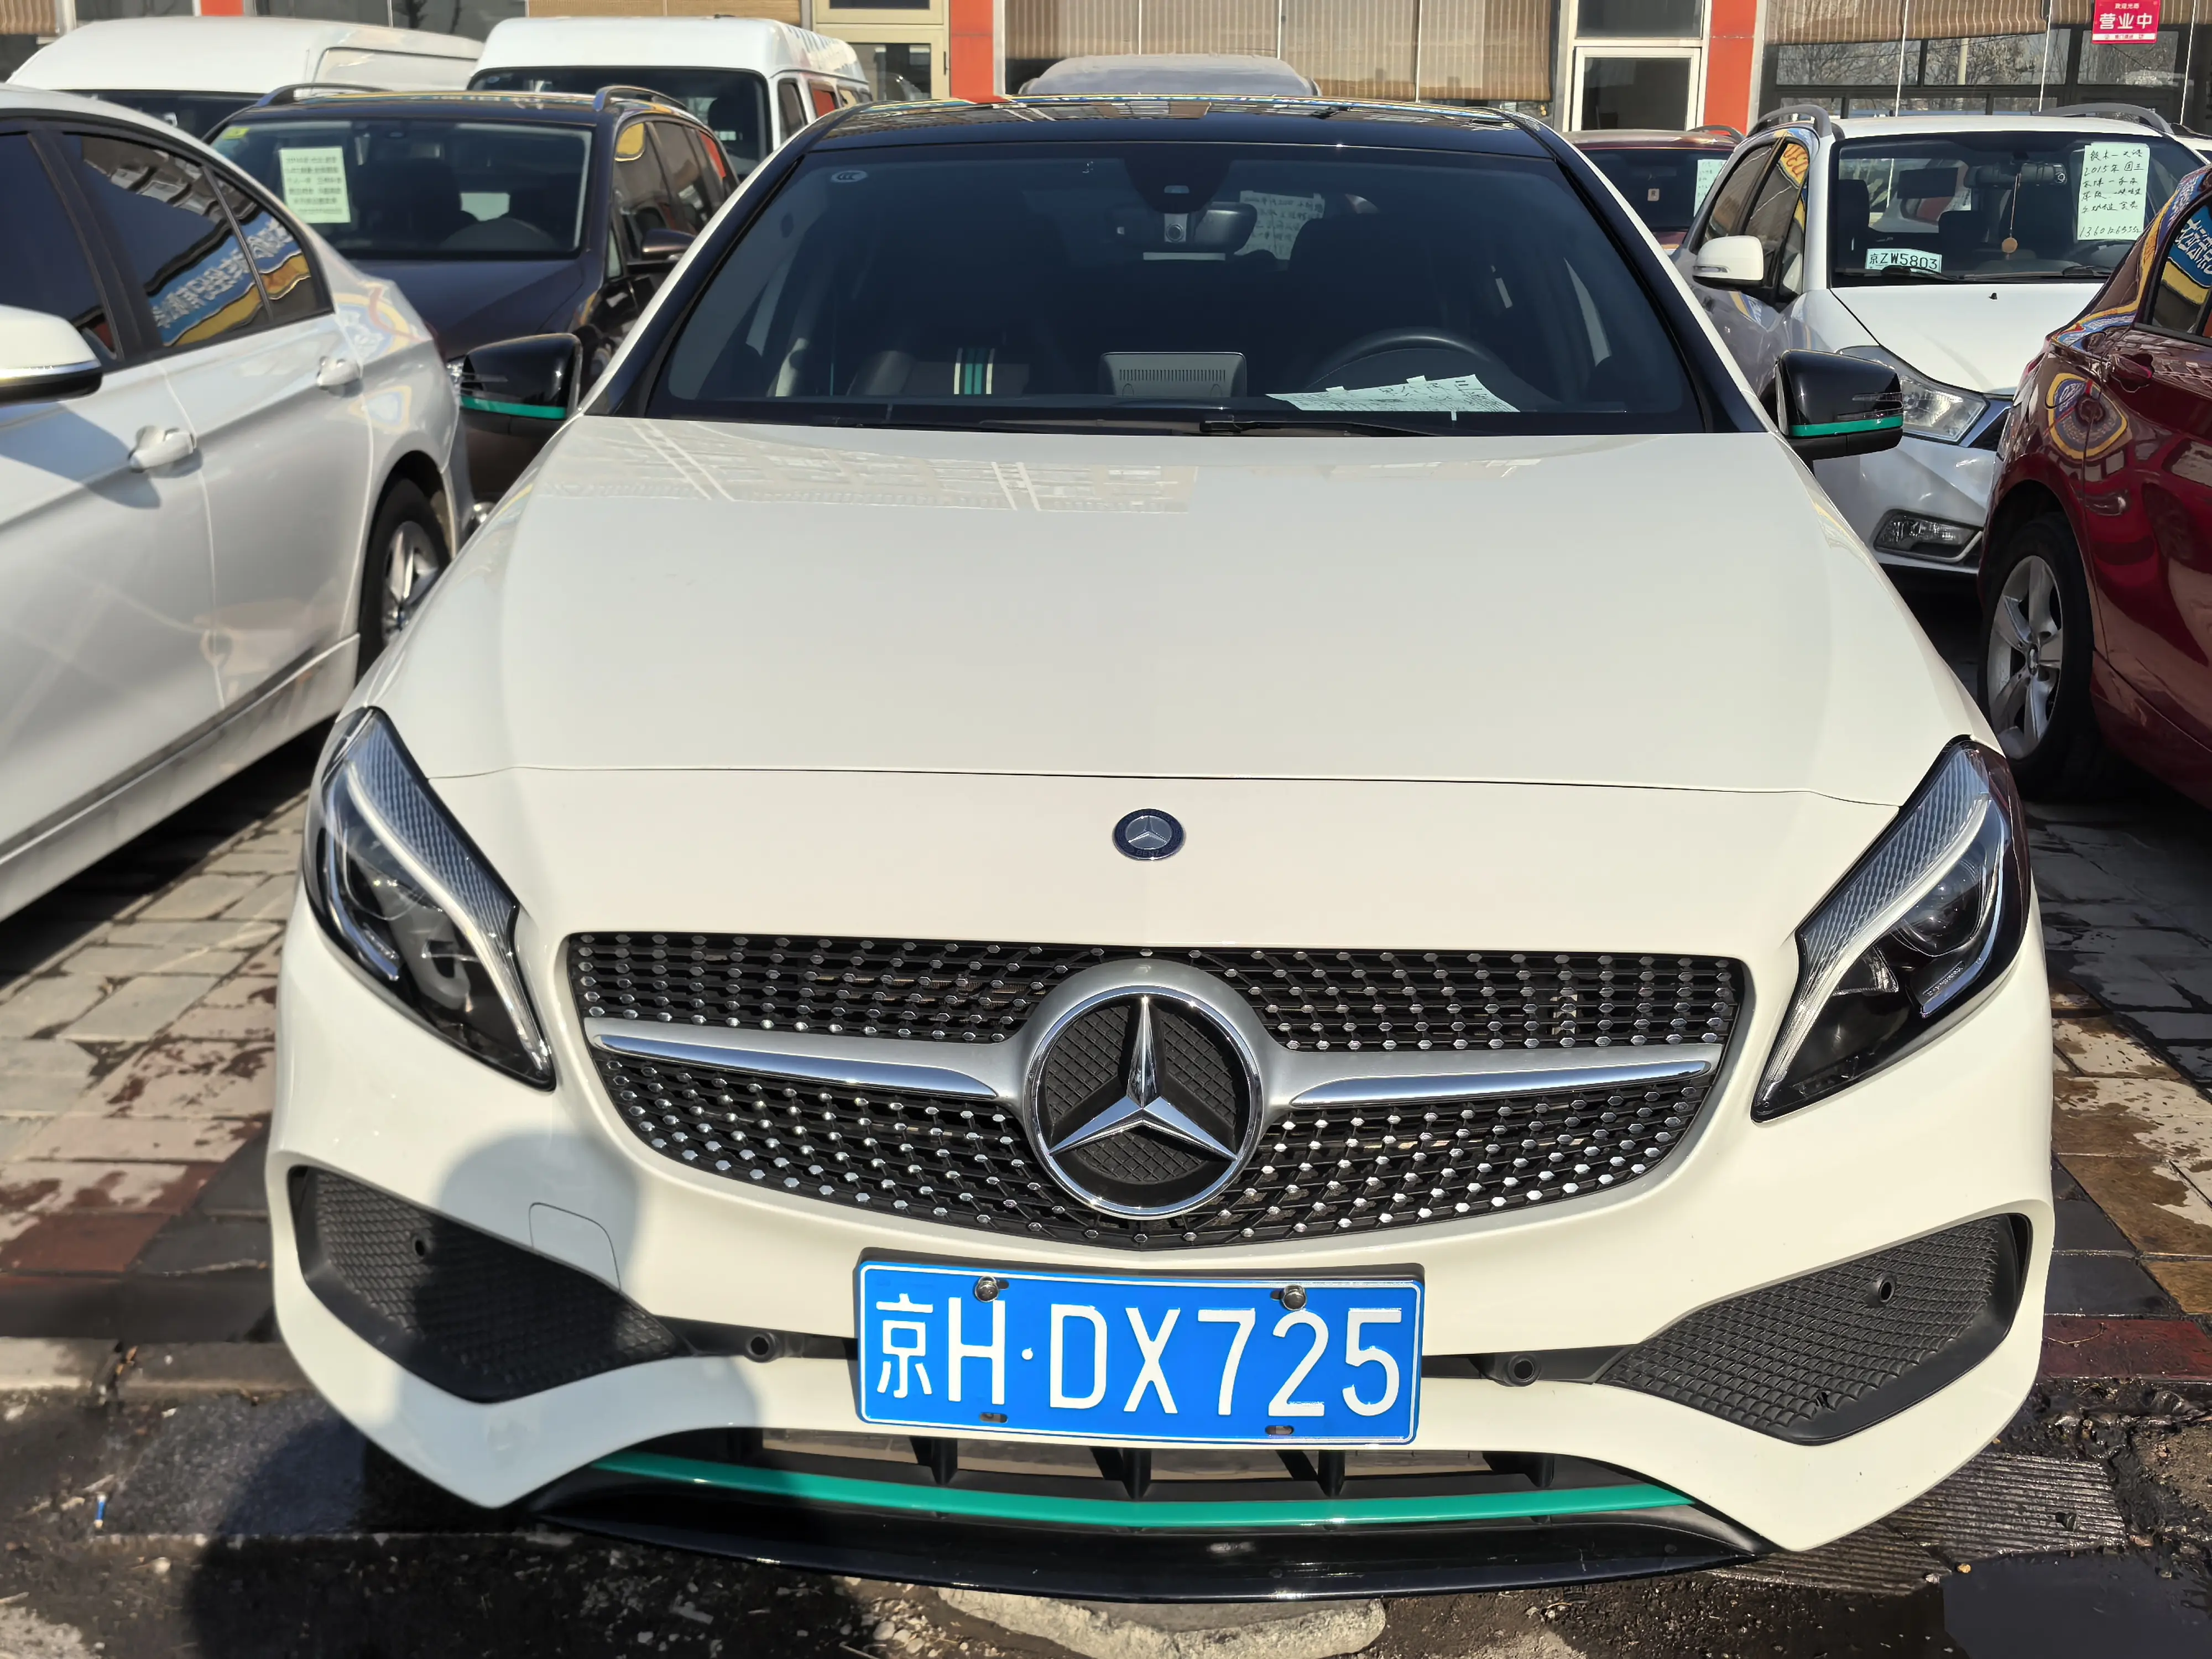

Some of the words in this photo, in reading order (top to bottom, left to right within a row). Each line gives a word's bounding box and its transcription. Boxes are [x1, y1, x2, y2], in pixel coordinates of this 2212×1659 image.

[2099, 12, 2153, 30] 营业中
[1869, 252, 1938, 270] 京ZW5803
[876, 1292, 1402, 1418] 京H·DX725
